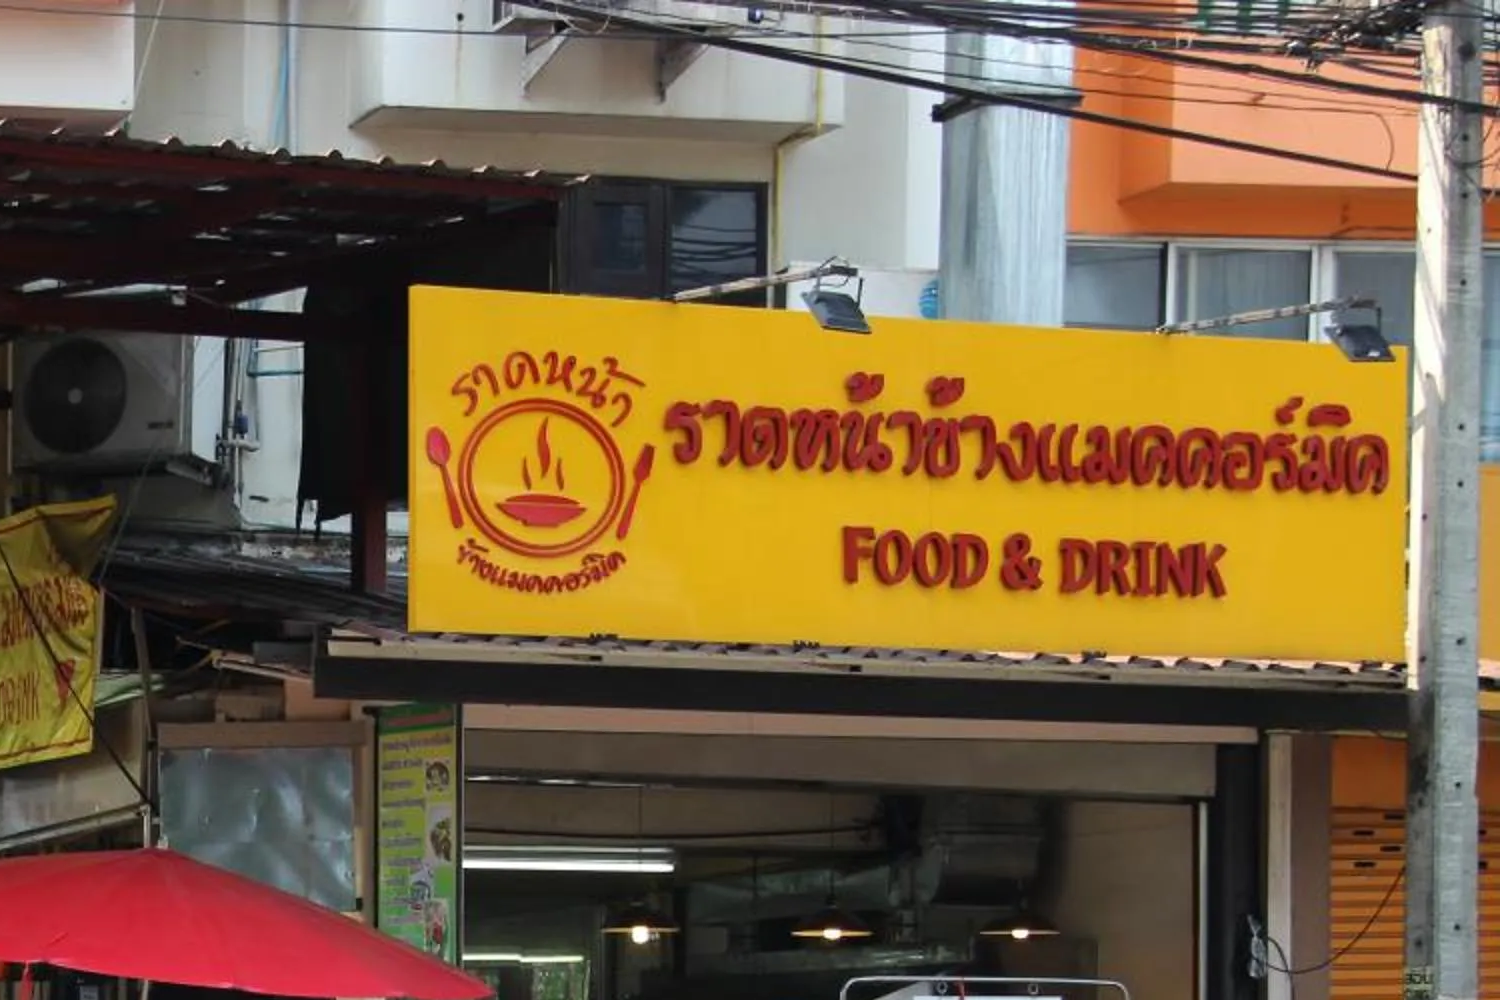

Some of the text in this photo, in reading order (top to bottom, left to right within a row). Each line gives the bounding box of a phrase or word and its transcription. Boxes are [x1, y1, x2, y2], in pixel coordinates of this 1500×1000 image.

[841, 526, 1228, 599] FOOD & DRINK
